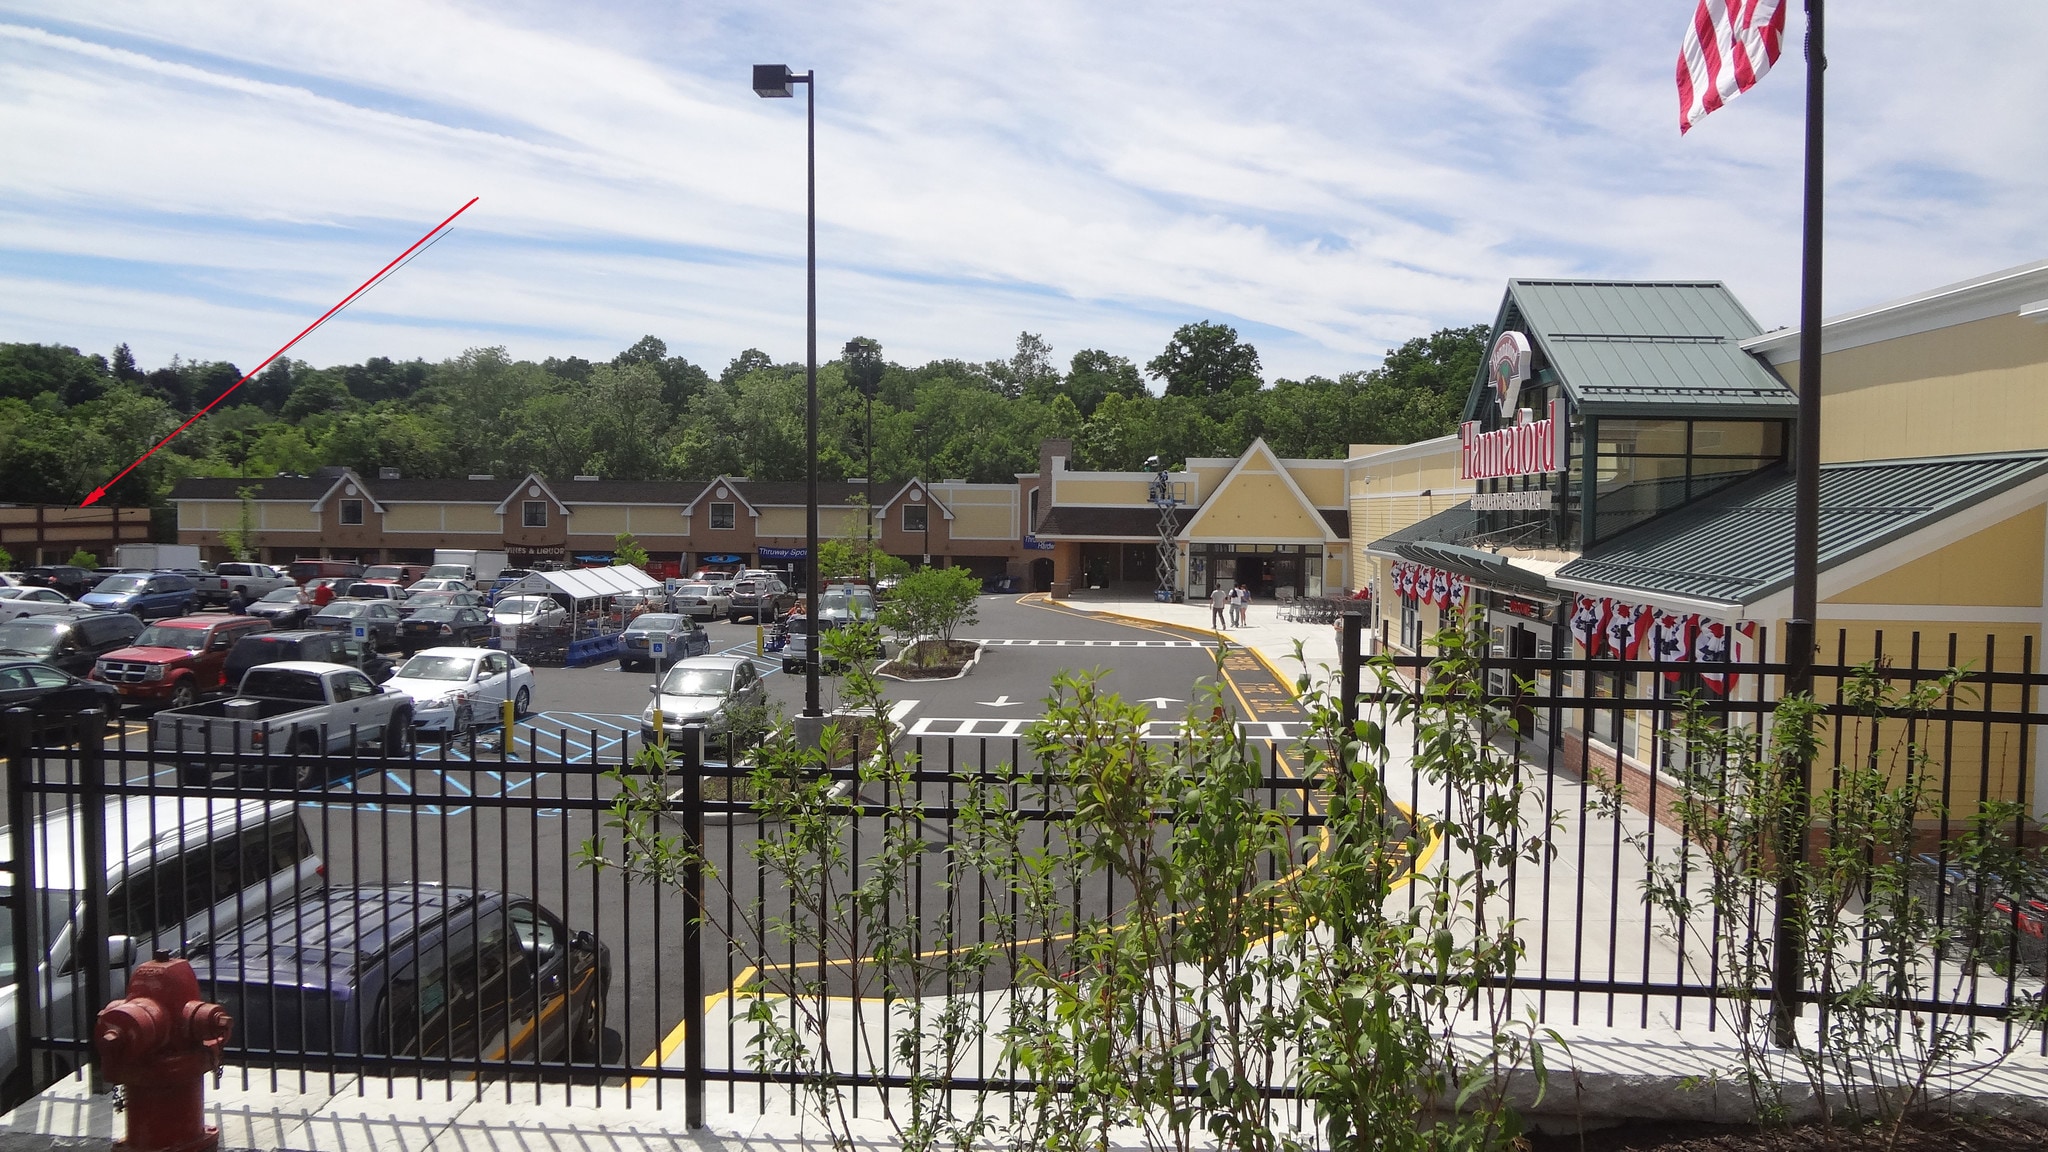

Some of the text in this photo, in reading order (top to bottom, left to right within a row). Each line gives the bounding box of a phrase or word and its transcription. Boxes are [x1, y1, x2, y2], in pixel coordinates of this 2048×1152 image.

[1461, 400, 1556, 480] Hannaford
[536, 547, 565, 555] LIQUOR
[759, 547, 789, 557] Thruway
